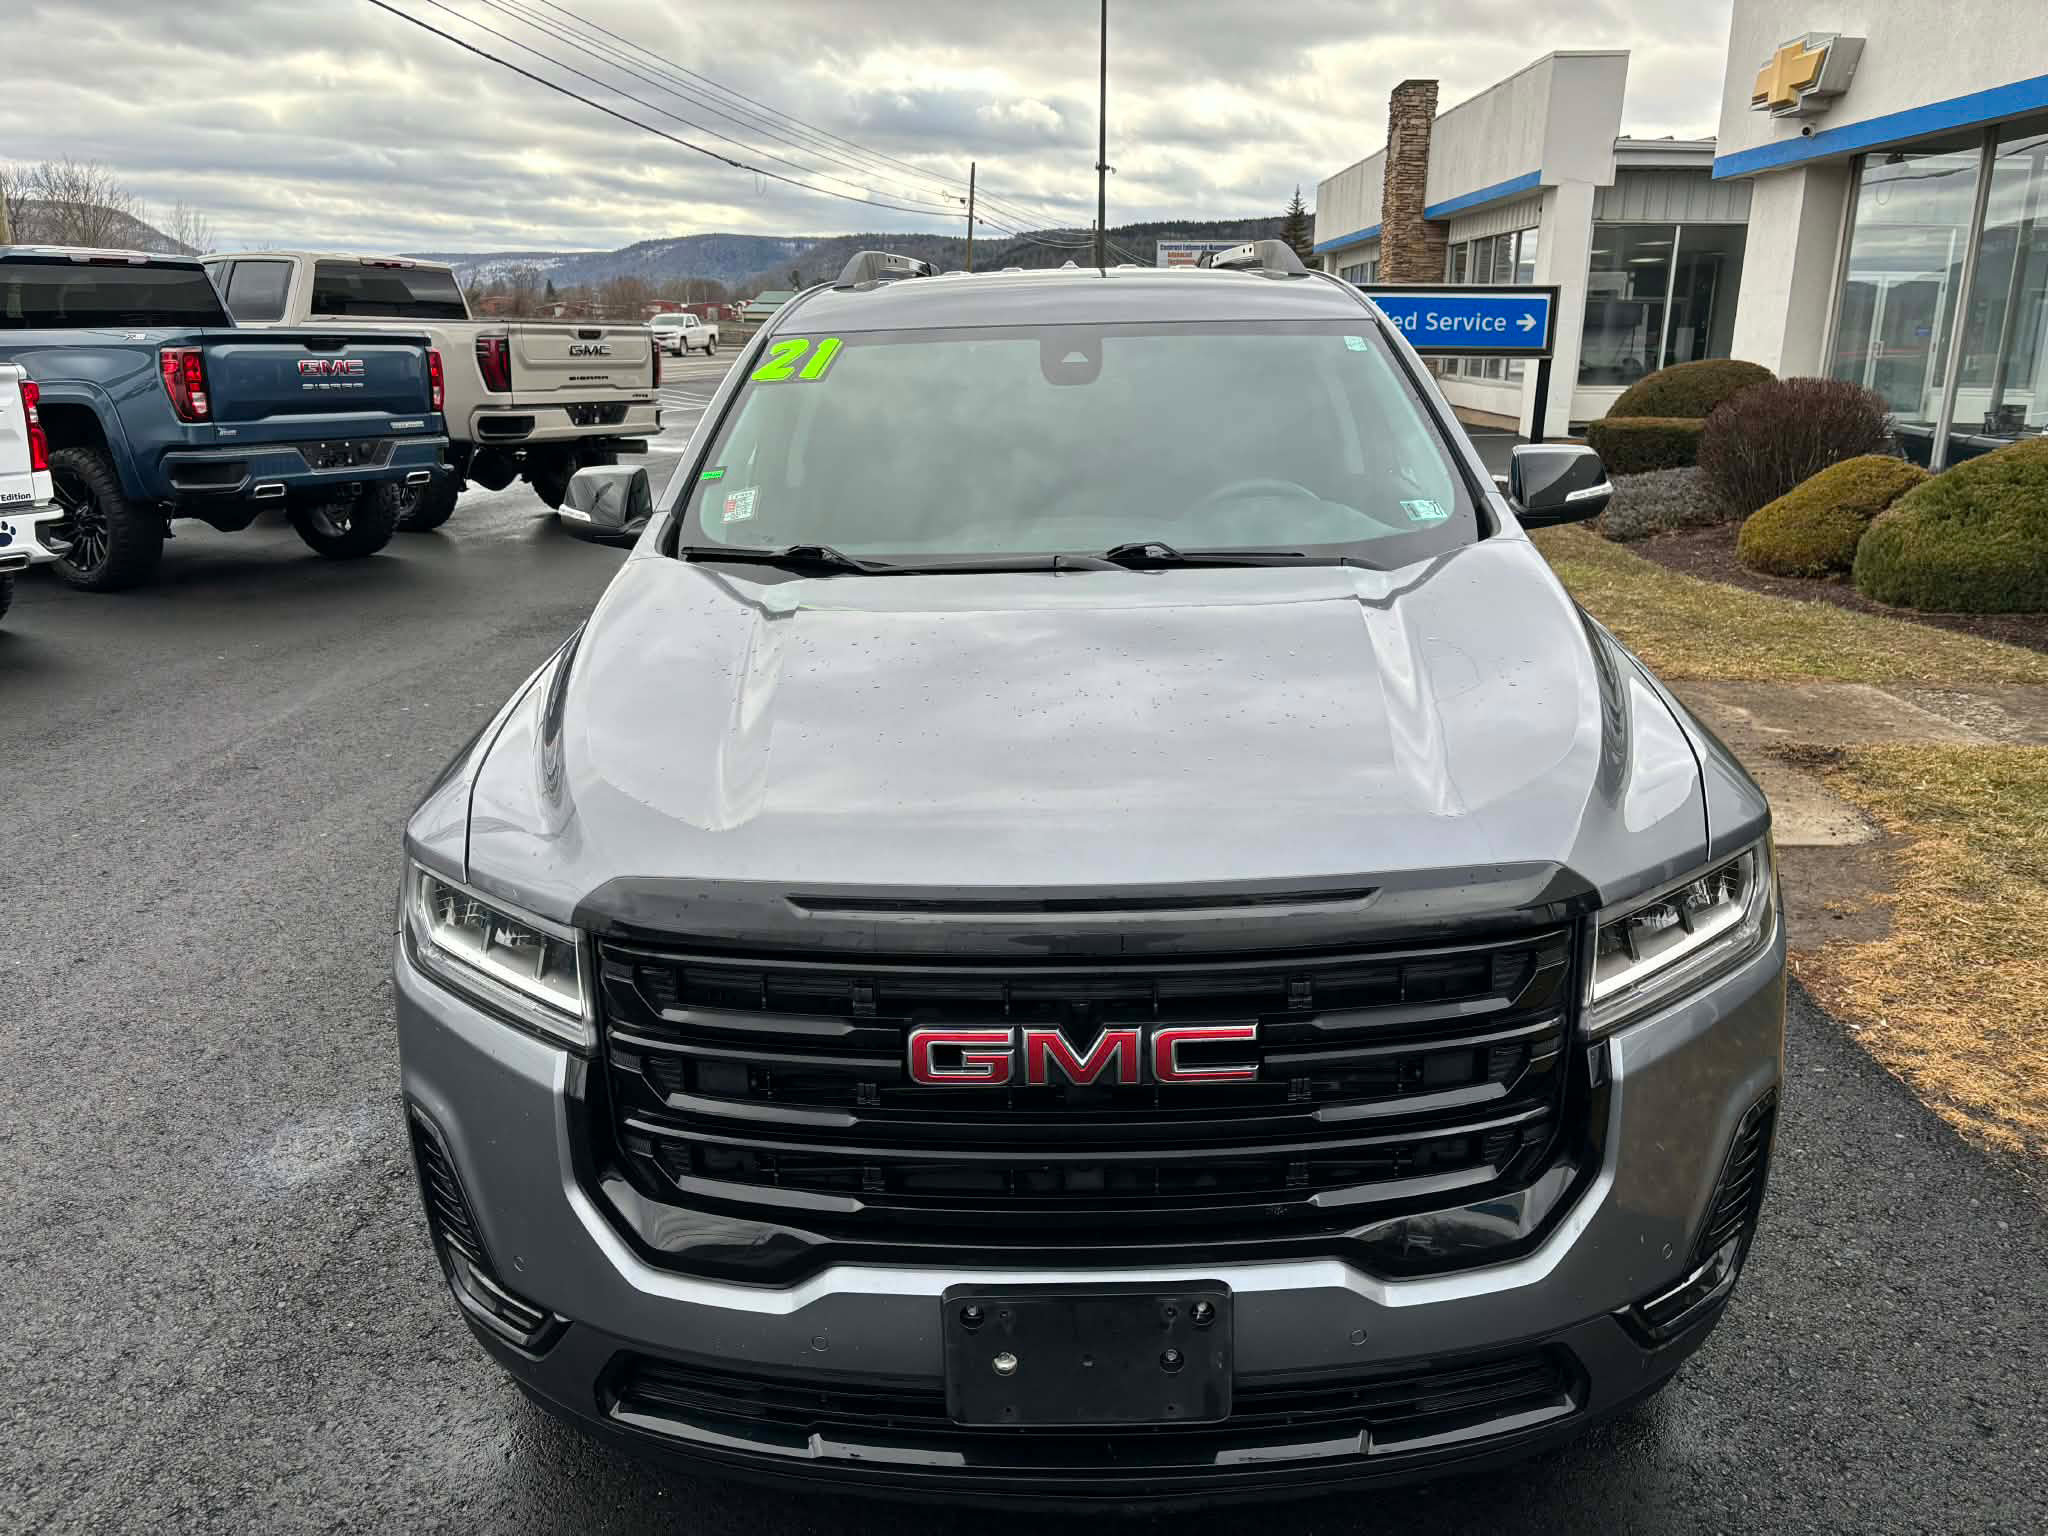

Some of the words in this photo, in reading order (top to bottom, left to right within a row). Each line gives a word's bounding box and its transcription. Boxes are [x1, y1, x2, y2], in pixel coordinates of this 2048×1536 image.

[1425, 312, 1508, 332] Service
[567, 343, 612, 357] GMC
[297, 359, 366, 377] GMC
[751, 338, 844, 382] 21
[1, 492, 32, 502] Edition
[908, 1023, 1259, 1086] GMC
